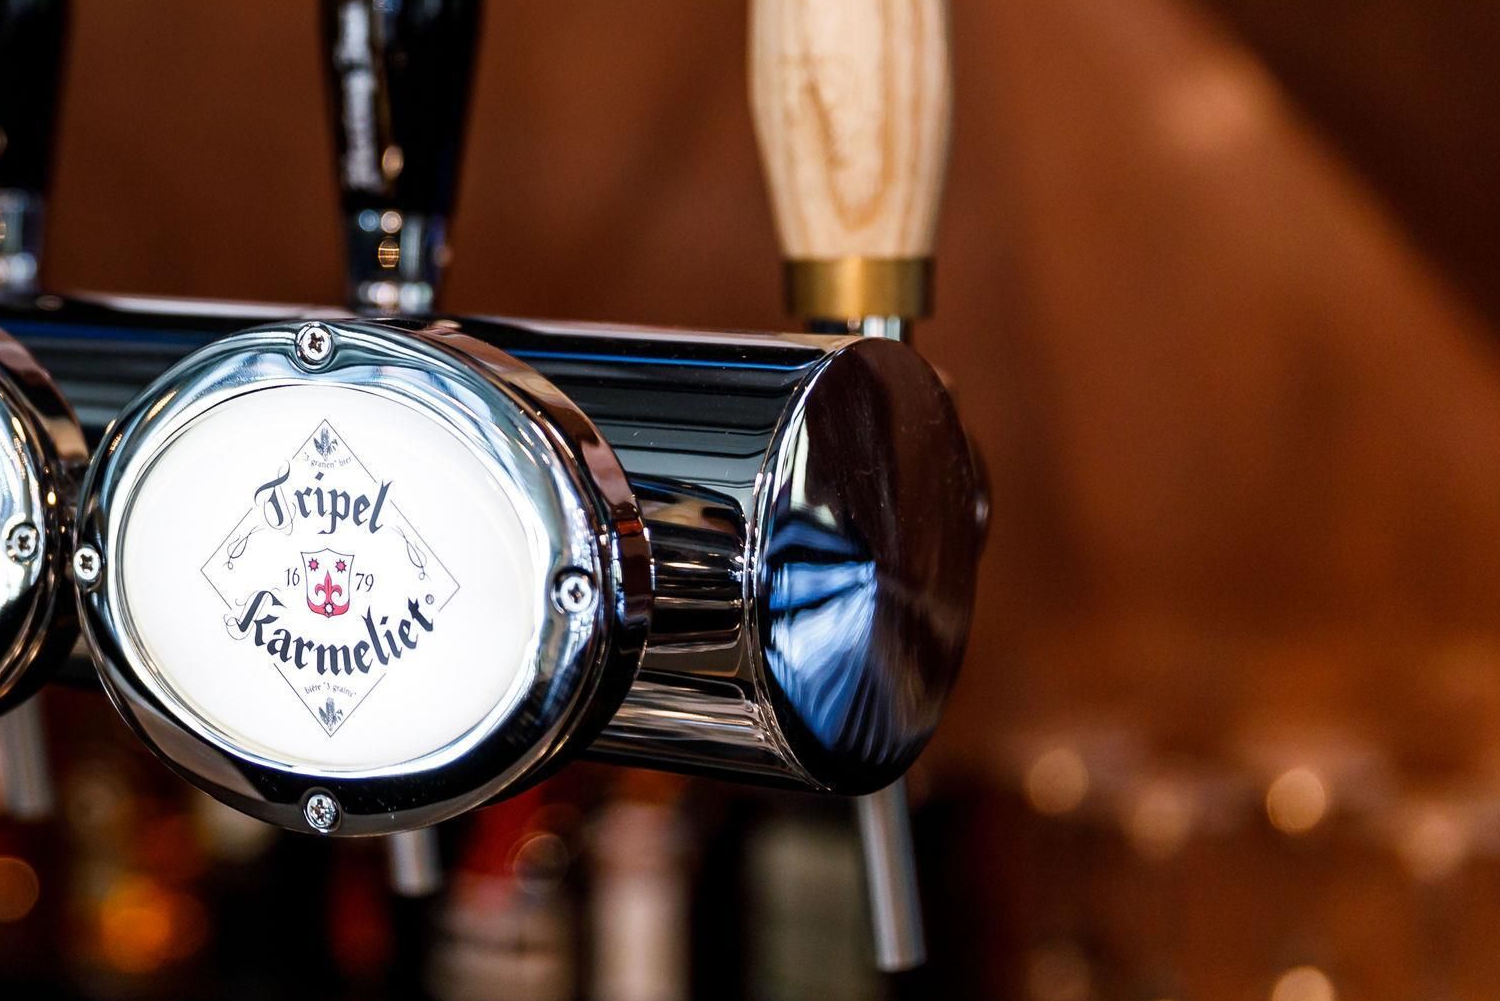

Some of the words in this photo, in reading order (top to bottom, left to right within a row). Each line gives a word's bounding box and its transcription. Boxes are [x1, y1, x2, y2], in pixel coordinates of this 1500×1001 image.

[254, 461, 393, 535] Tripel
[284, 567, 301, 587] 16
[355, 572, 375, 592] 79
[225, 588, 434, 676] Karmeliet
